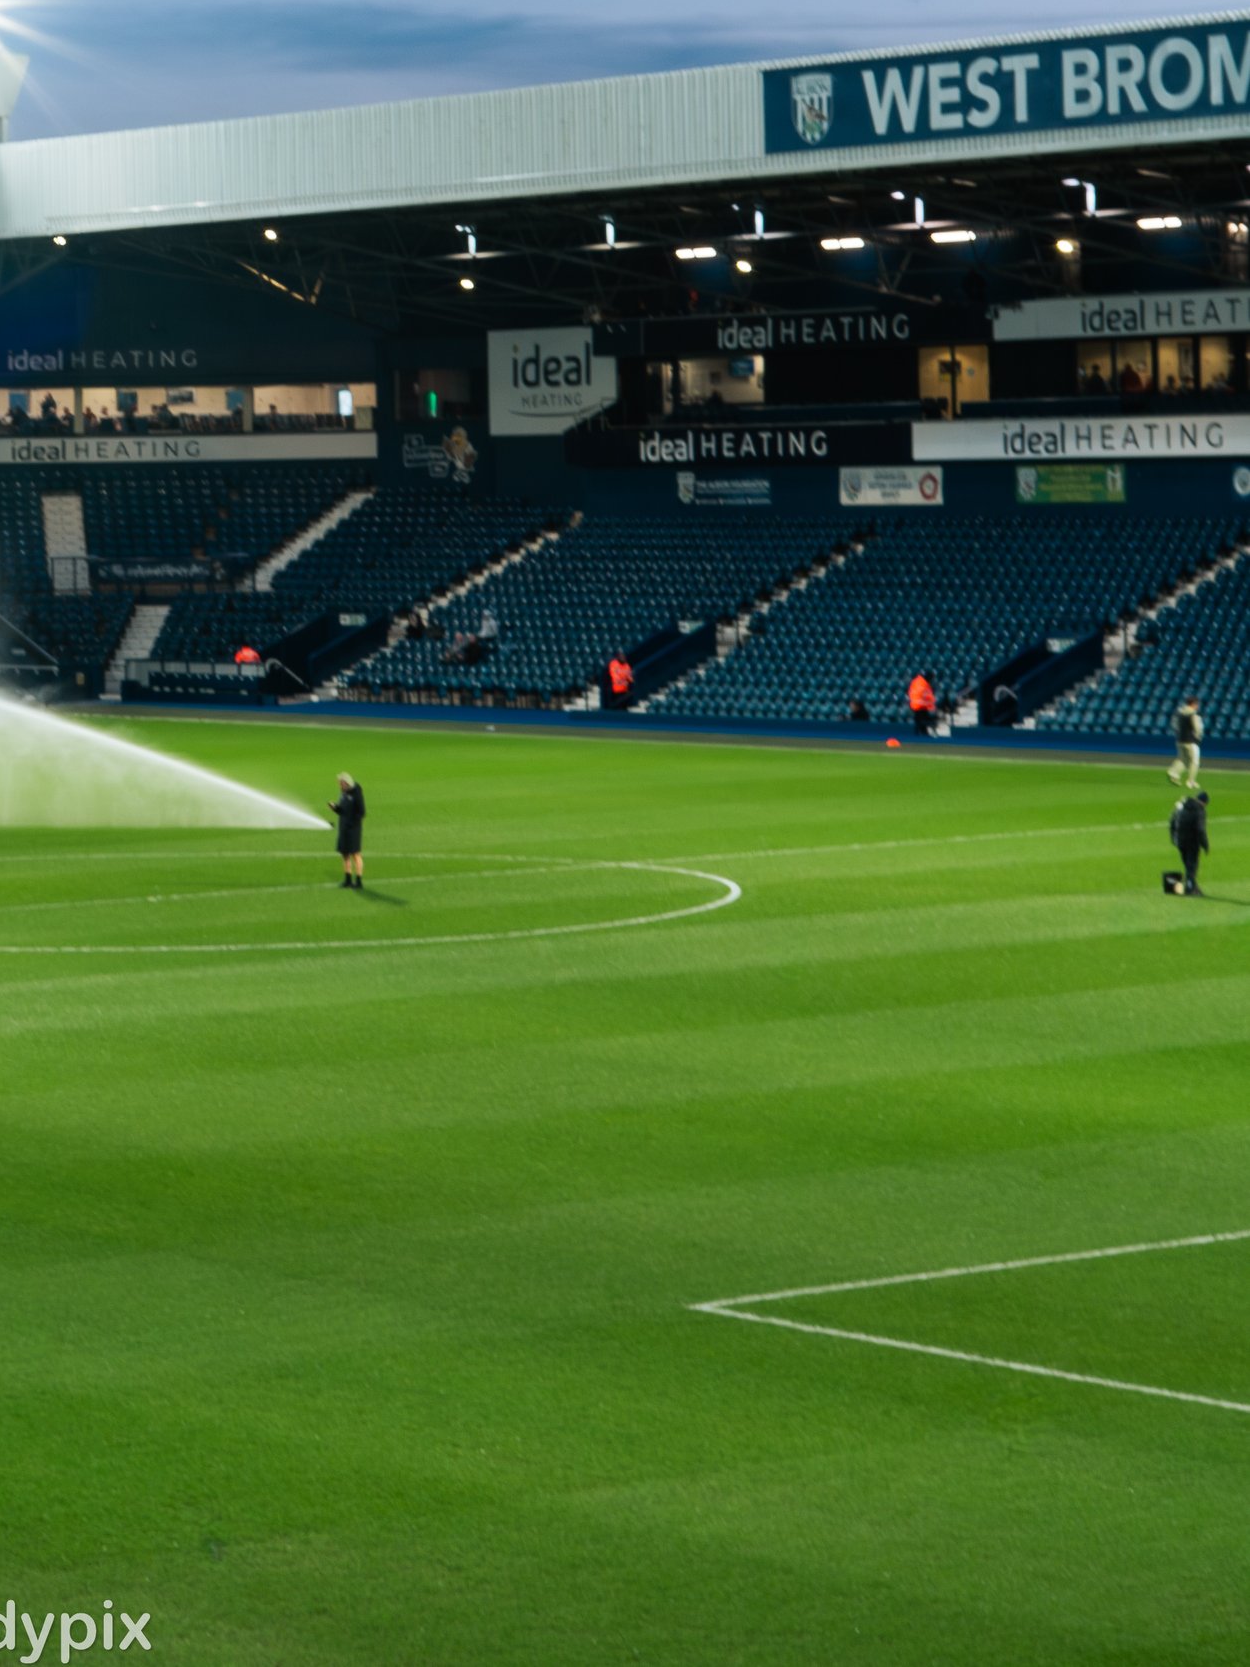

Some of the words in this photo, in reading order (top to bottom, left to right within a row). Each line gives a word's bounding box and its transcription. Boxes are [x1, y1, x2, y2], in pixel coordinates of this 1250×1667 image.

[861, 53, 1040, 135] WEST
[1062, 32, 1250, 119] BROM
[717, 317, 773, 349] ideal
[780, 314, 910, 344] HEATING
[1080, 299, 1146, 333] ideal
[7, 349, 64, 371] ideal
[70, 349, 198, 368] HEATING
[512, 340, 591, 389] ideal
[521, 393, 582, 408] HEATING
[11, 439, 67, 461] ideal
[73, 440, 201, 458] HEATING
[639, 430, 694, 462] ideal
[701, 430, 828, 458] HEATING
[1002, 421, 1066, 455] ideal
[1073, 421, 1224, 451] HEATING
